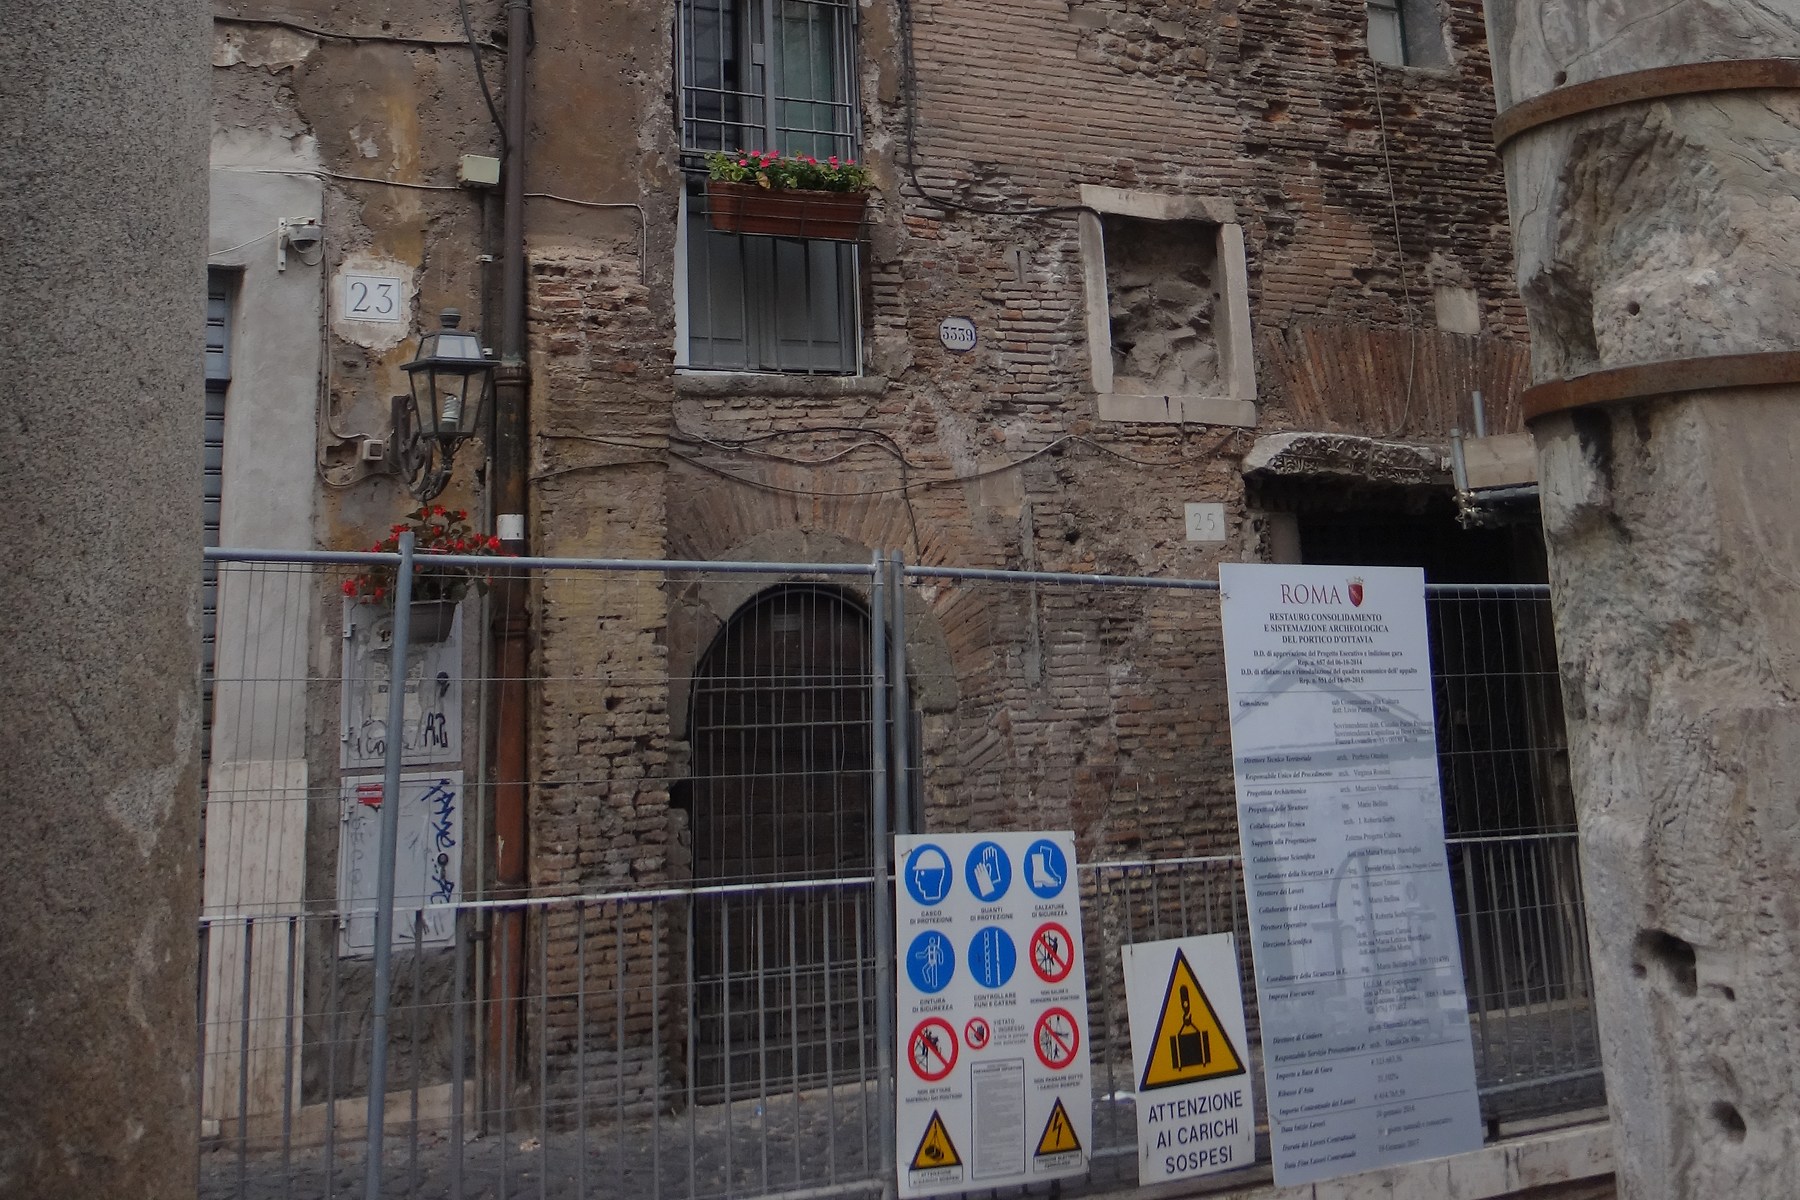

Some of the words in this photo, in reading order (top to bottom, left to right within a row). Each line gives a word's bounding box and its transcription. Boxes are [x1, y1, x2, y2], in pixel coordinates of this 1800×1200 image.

[351, 281, 393, 314] 23
[942, 326, 973, 341] 3339
[1193, 512, 1215, 531] 25
[1280, 583, 1342, 604] ROMA
[1269, 612, 1310, 622] RESTAURO
[1311, 613, 1382, 622] CONSOLIDAMENTO
[1264, 624, 1268, 632] E
[1270, 624, 1327, 633] SISTEMAZIONE
[1328, 625, 1389, 633] ARCHEOLOGICA
[1282, 636, 1297, 644] DEL
[1298, 636, 1332, 644] PORTICO
[1334, 636, 1373, 644] D'OTTAVIA
[1038, 910, 1068, 918] SICUREZZA
[916, 917, 953, 925] PROTEZIONE
[973, 992, 1016, 1001] CONTROLLARE
[920, 1005, 953, 1013] SICUREZZA
[1148, 1090, 1243, 1124] ATTENZIONE
[1156, 1130, 1172, 1149] AI
[1177, 1118, 1238, 1144] CARICHI
[1165, 1145, 1232, 1174] SOSPESI
